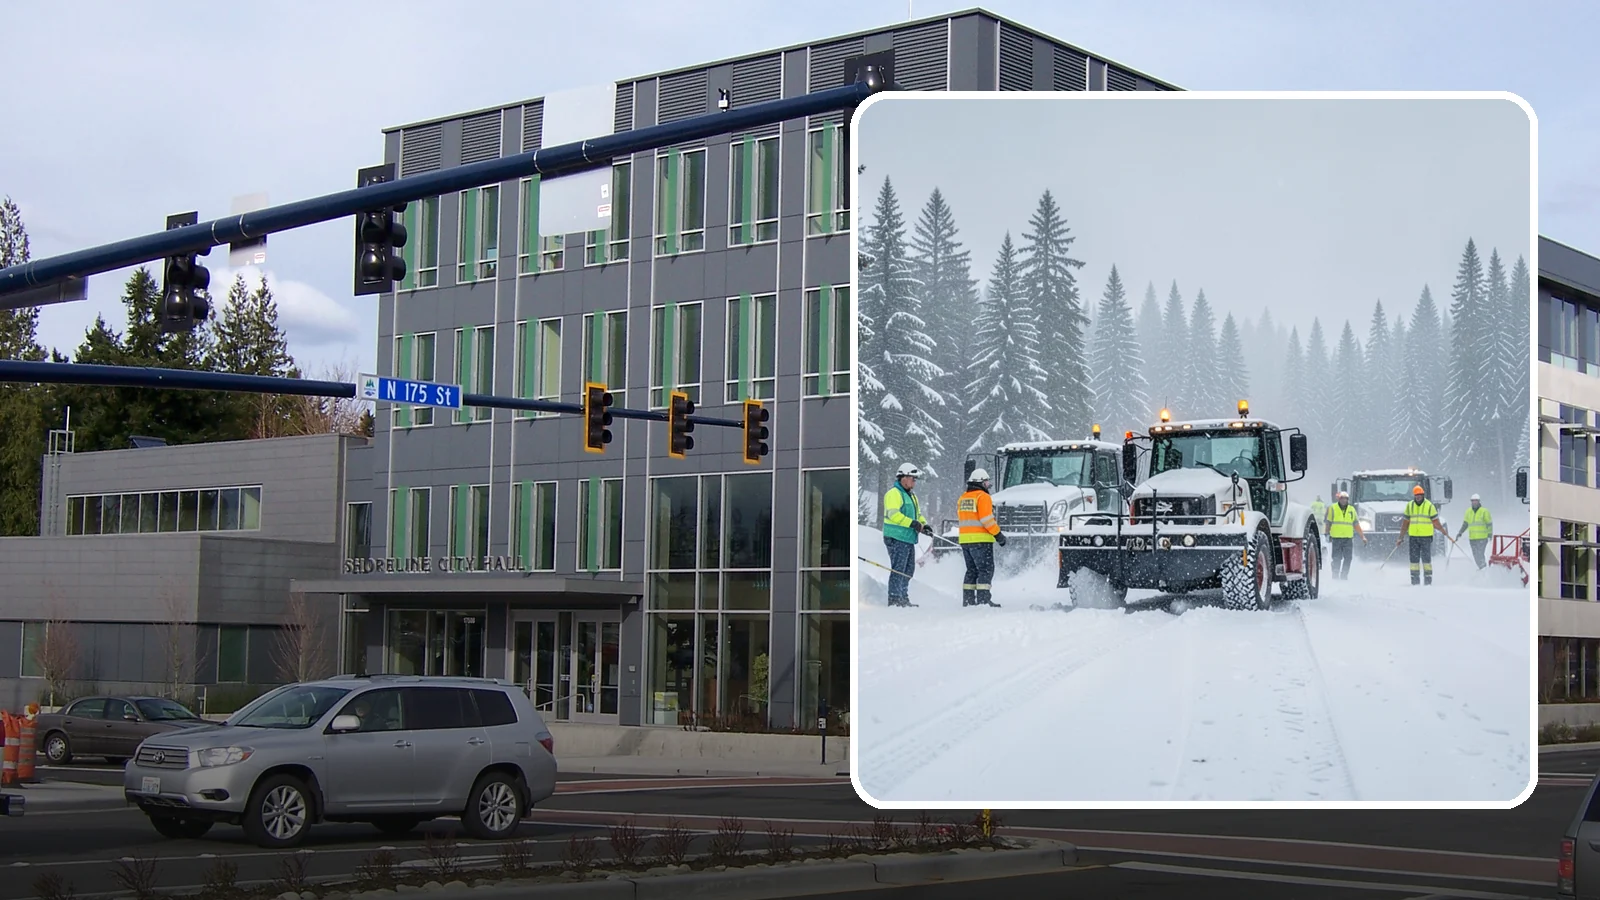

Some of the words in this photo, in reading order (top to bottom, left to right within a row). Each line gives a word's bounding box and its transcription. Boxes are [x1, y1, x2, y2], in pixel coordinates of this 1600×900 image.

[387, 381, 396, 399] N
[405, 383, 427, 403] 175
[436, 386, 451, 405] St
[343, 557, 432, 574] SHORELINE
[438, 556, 475, 573] CITY
[484, 556, 526, 572] HALL
